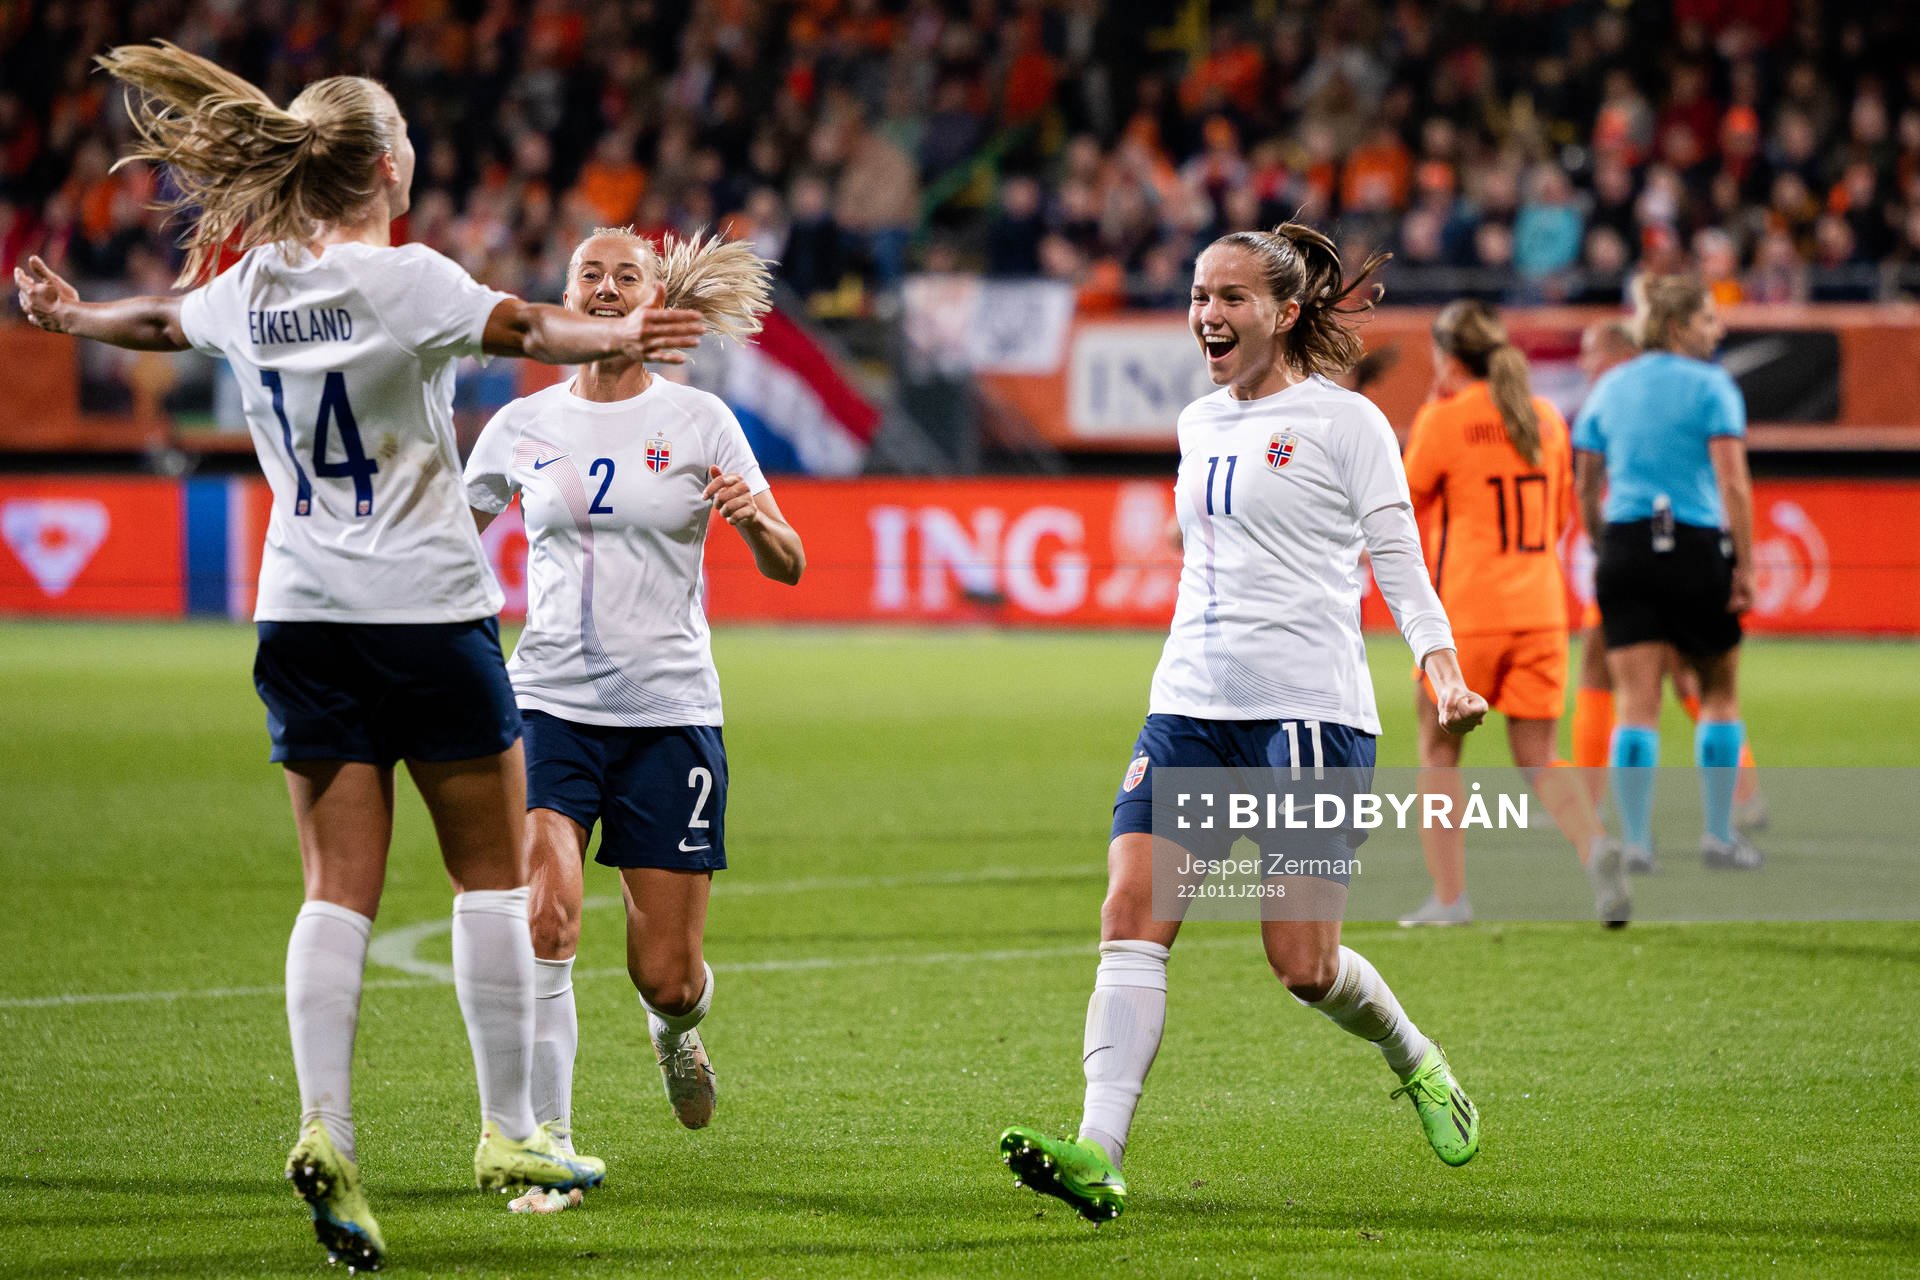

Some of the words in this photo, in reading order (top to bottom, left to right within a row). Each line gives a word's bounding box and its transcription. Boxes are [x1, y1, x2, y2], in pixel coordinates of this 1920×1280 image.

[249, 308, 352, 344] EIKELAND
[260, 369, 379, 517] 14
[588, 457, 616, 515] 2
[1206, 455, 1238, 516] 11
[1486, 474, 1547, 553] 10
[866, 503, 1090, 615] ING
[1281, 720, 1325, 781] 11
[687, 766, 713, 828] 2
